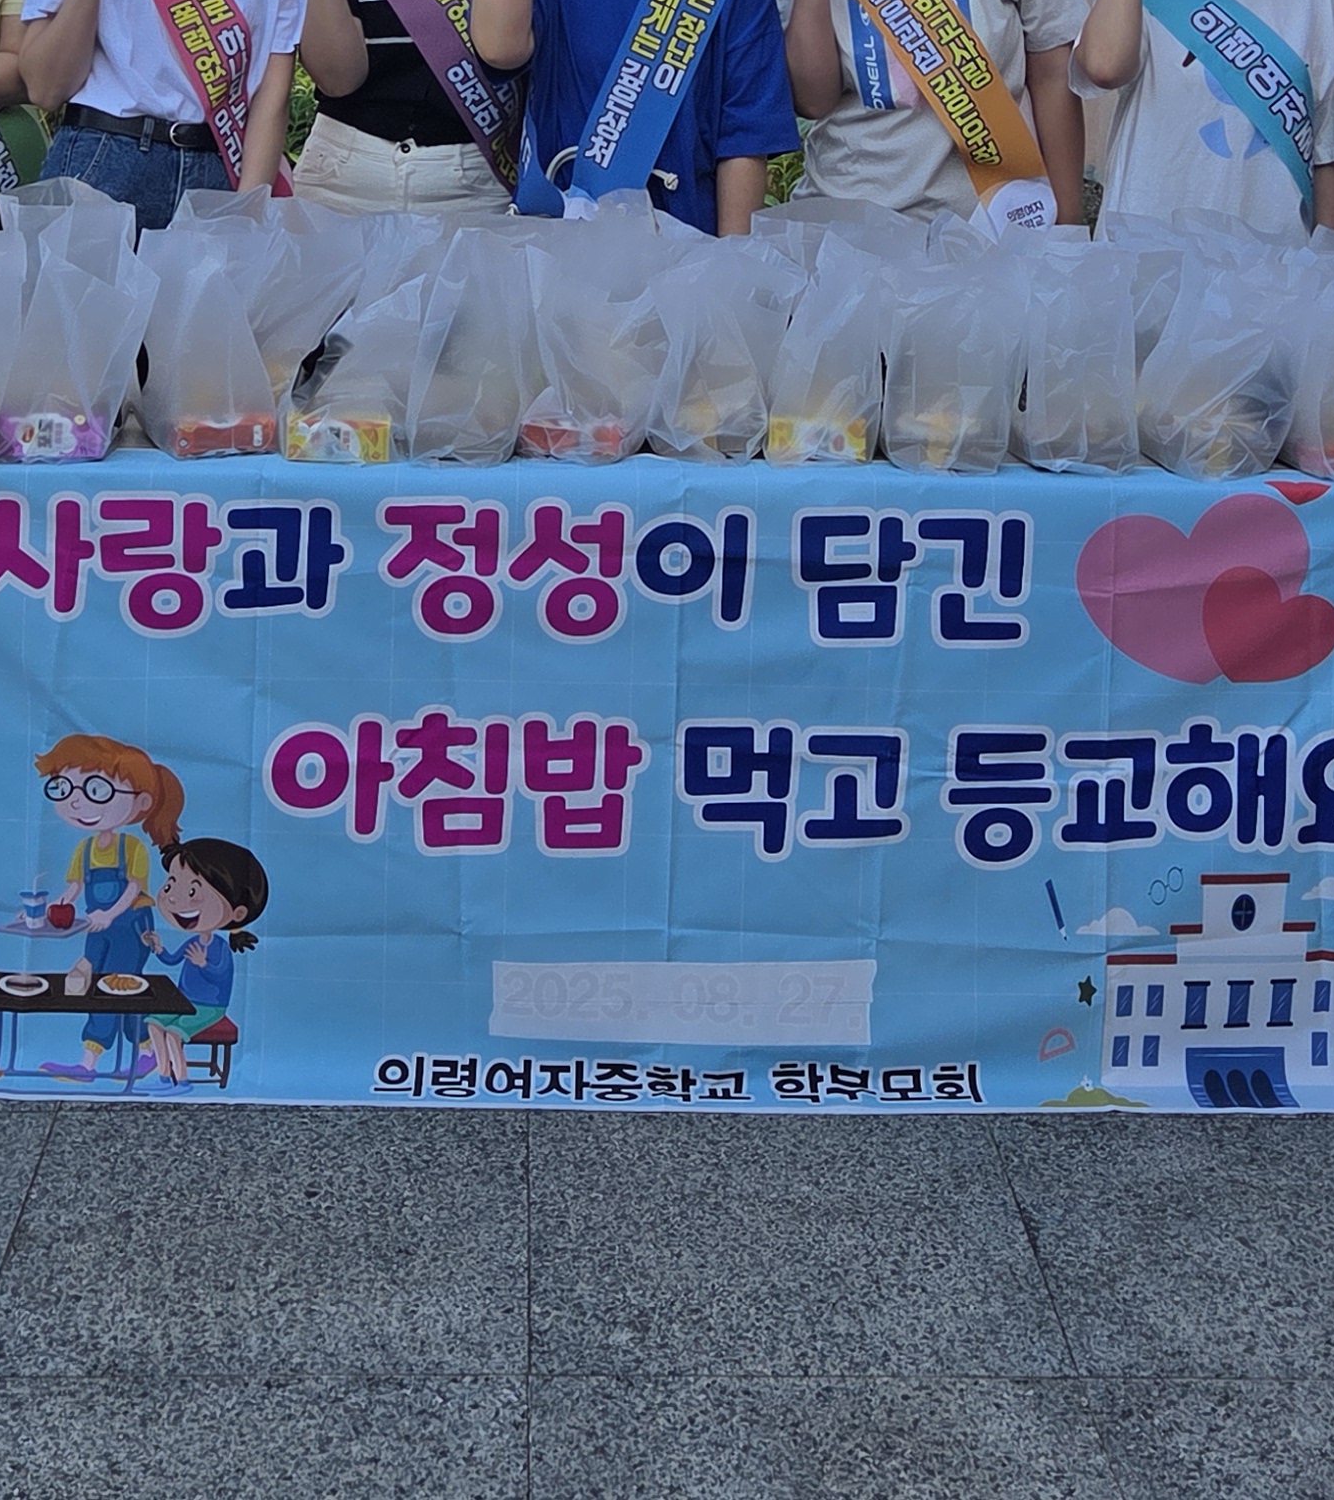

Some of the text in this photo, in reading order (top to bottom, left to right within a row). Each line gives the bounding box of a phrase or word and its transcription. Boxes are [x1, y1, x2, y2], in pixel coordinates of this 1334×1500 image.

[653, 11, 708, 96] 장난이
[446, 59, 503, 137] 안전한
[930, 68, 1002, 166] 깊은우정
[383, 503, 750, 638] 정성이
[799, 514, 1027, 641] 담긴
[270, 711, 646, 851] 아침밥
[682, 725, 906, 856] 먹고
[502, 970, 652, 1022] 2025.
[373, 1053, 984, 1104] 의령여자중학교 학부모회
